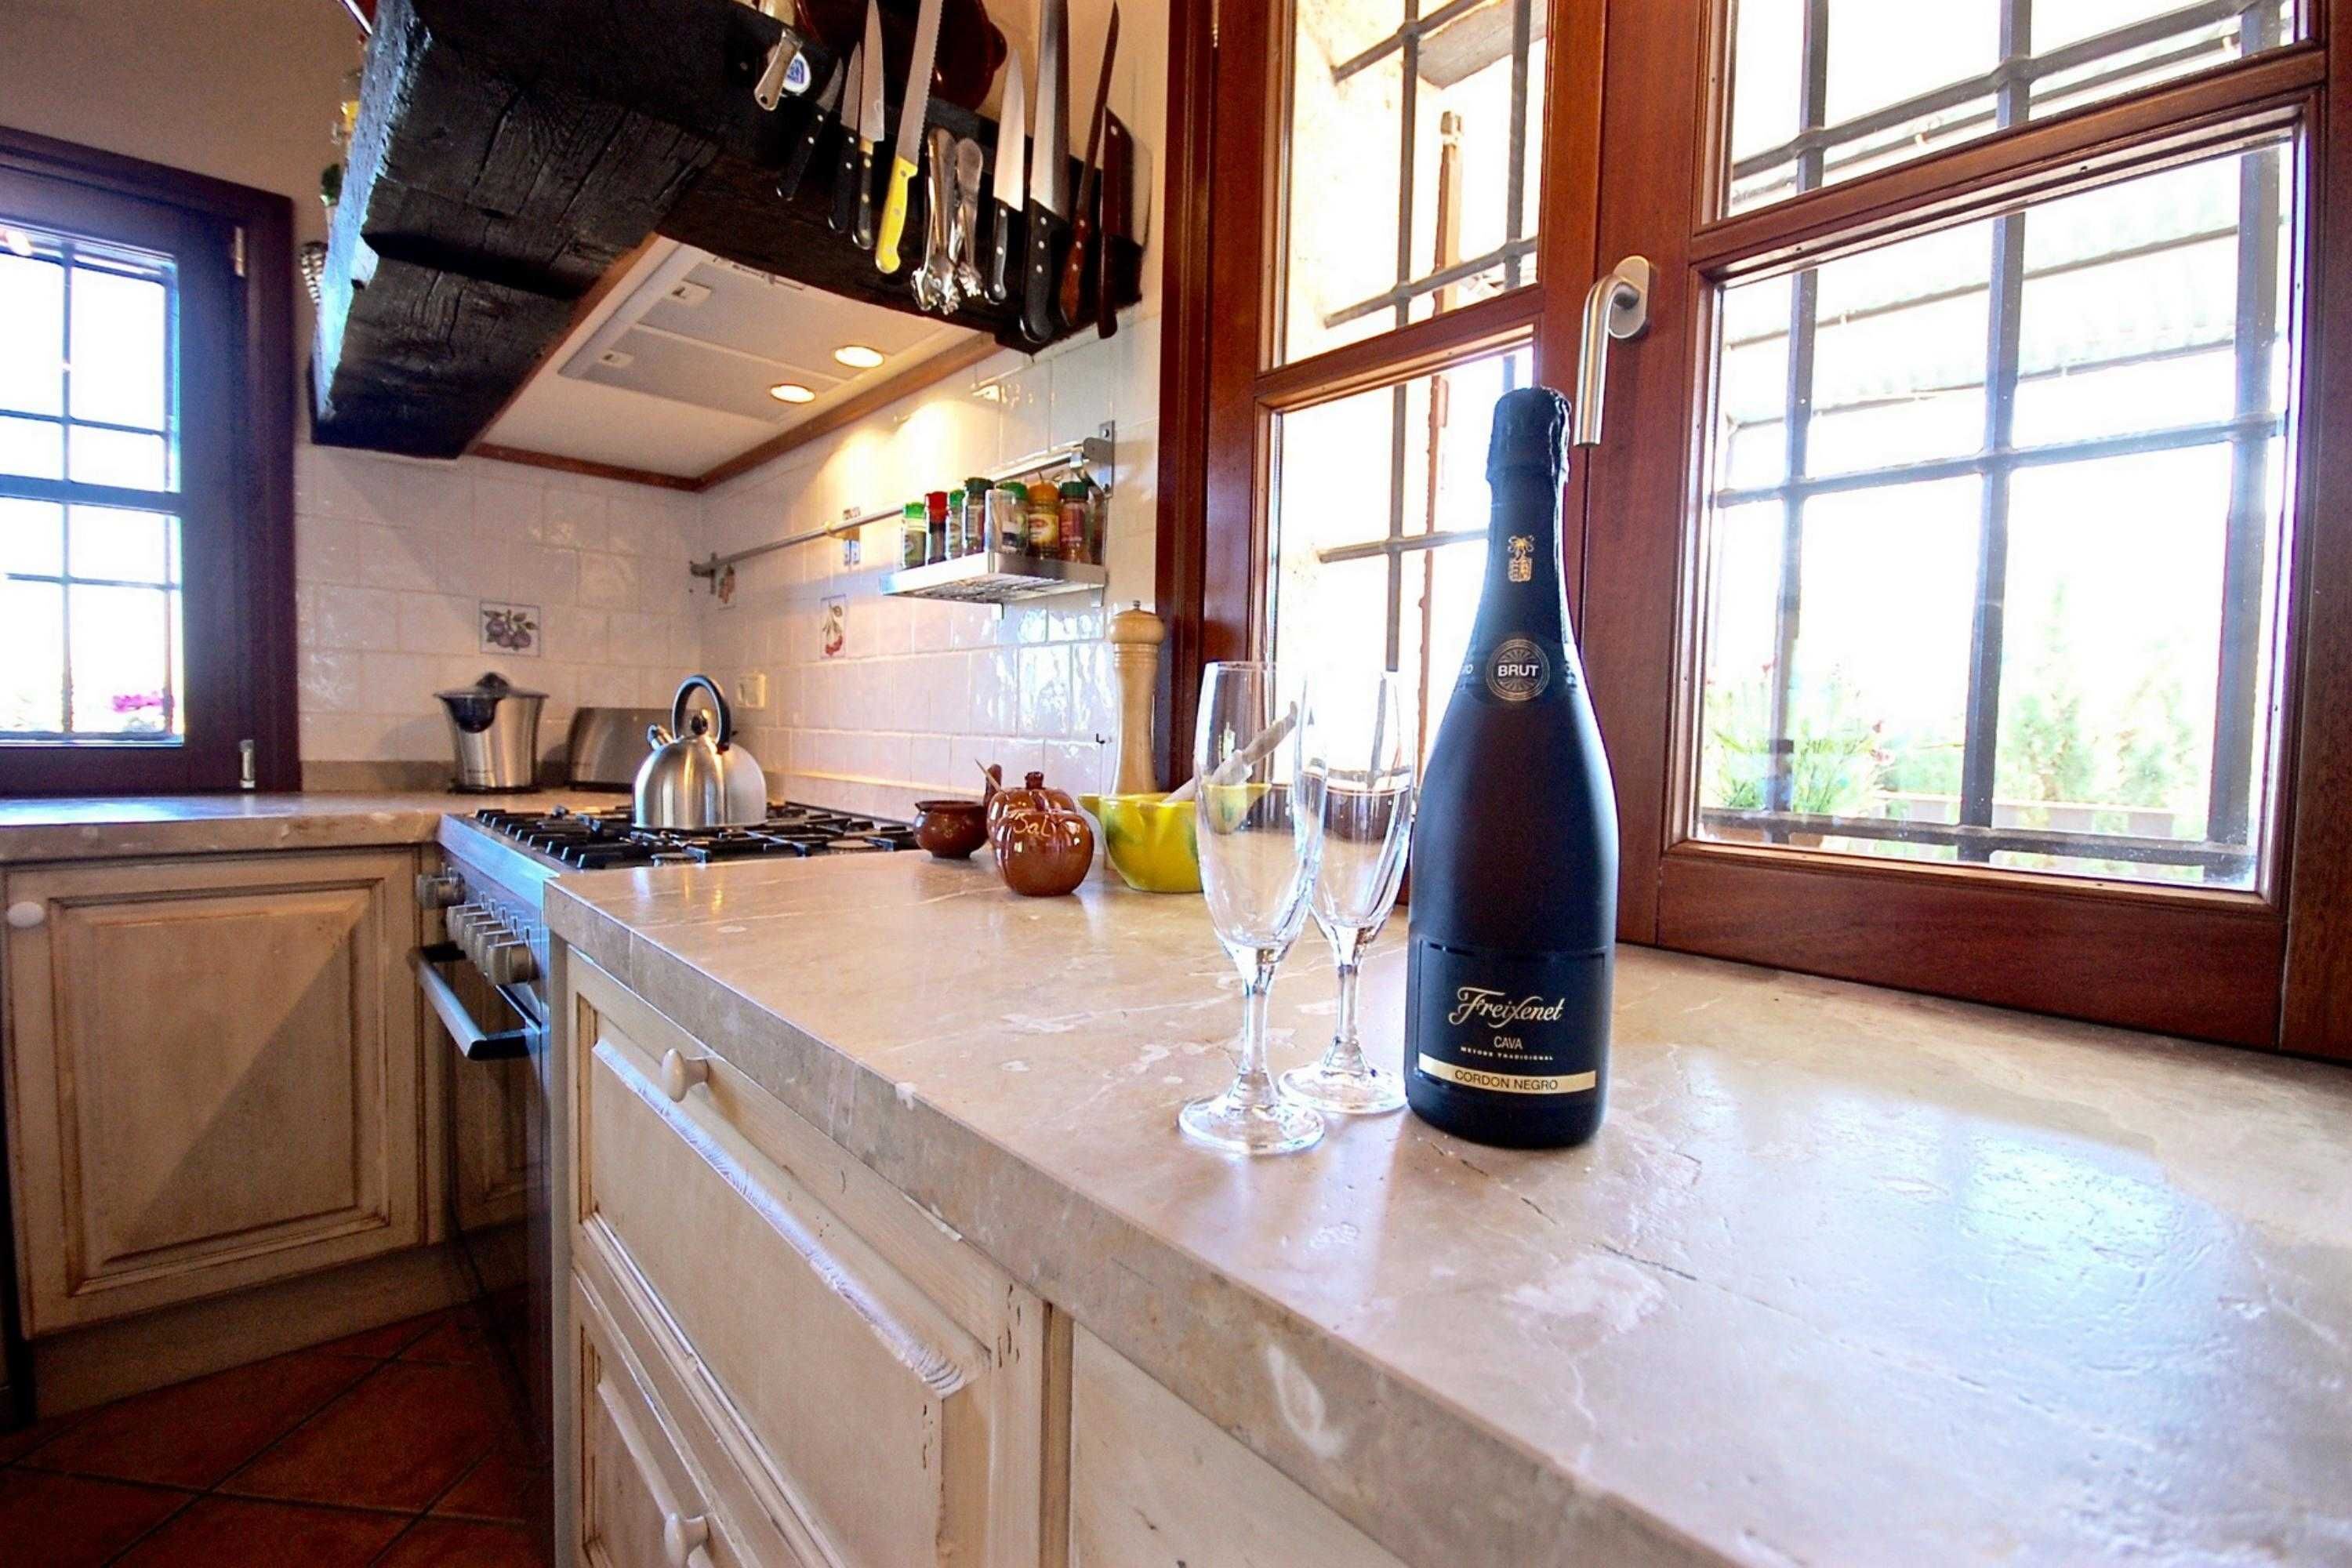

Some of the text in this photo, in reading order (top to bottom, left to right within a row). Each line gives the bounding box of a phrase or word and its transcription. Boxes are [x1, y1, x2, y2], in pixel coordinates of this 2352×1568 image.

[1497, 664, 1539, 677] BRUT
[1448, 986, 1566, 1029] Freixenet
[1494, 1036, 1524, 1050] CAVA
[1454, 1069, 1559, 1091] CORDON NEGRO
